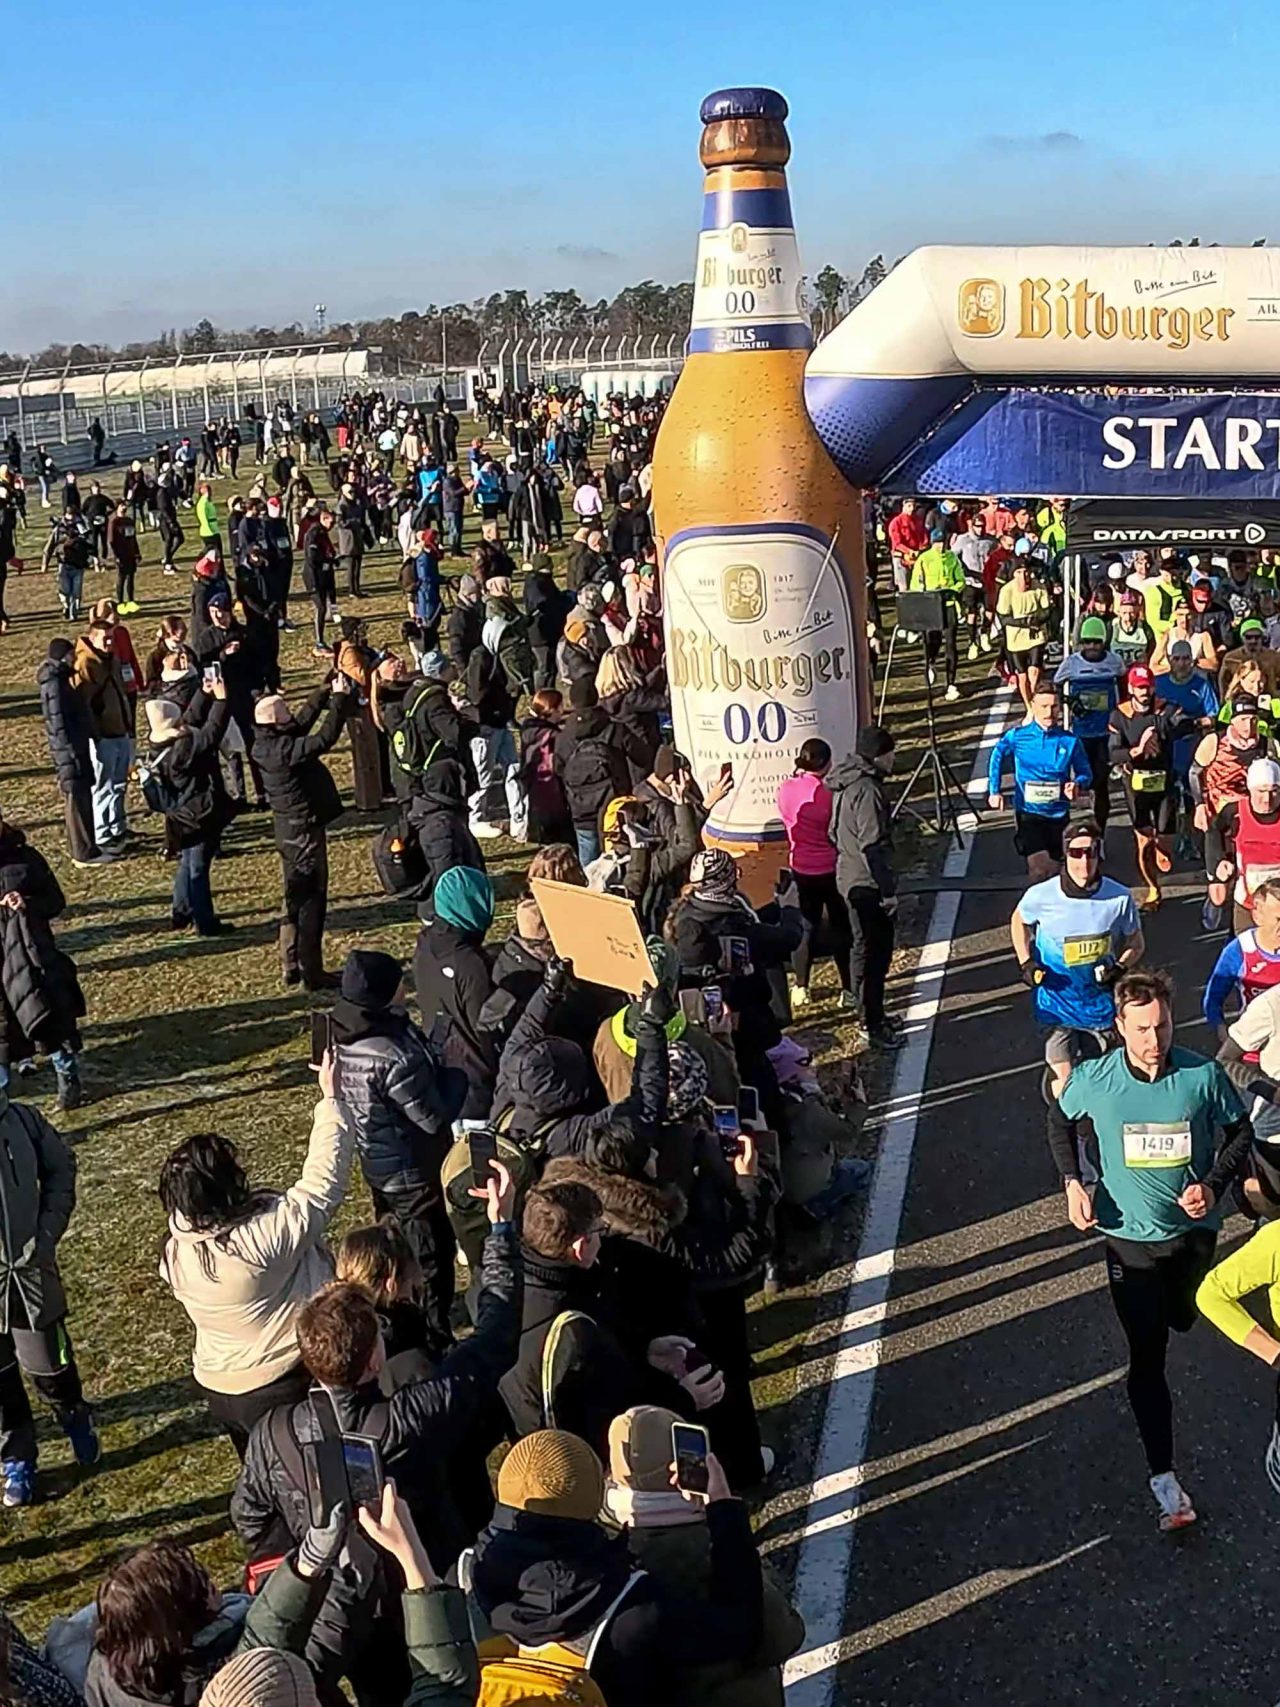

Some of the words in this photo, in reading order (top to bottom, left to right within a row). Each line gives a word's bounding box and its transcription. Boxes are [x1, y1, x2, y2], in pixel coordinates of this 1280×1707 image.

[725, 290, 755, 315] 0.0
[1015, 277, 1236, 350] Bitburger
[725, 327, 756, 343] PILS
[1093, 529, 1241, 541] DATASPORT
[671, 628, 846, 698] Bitburger
[723, 700, 787, 745] 0.0
[1142, 1137, 1174, 1151] 1419
